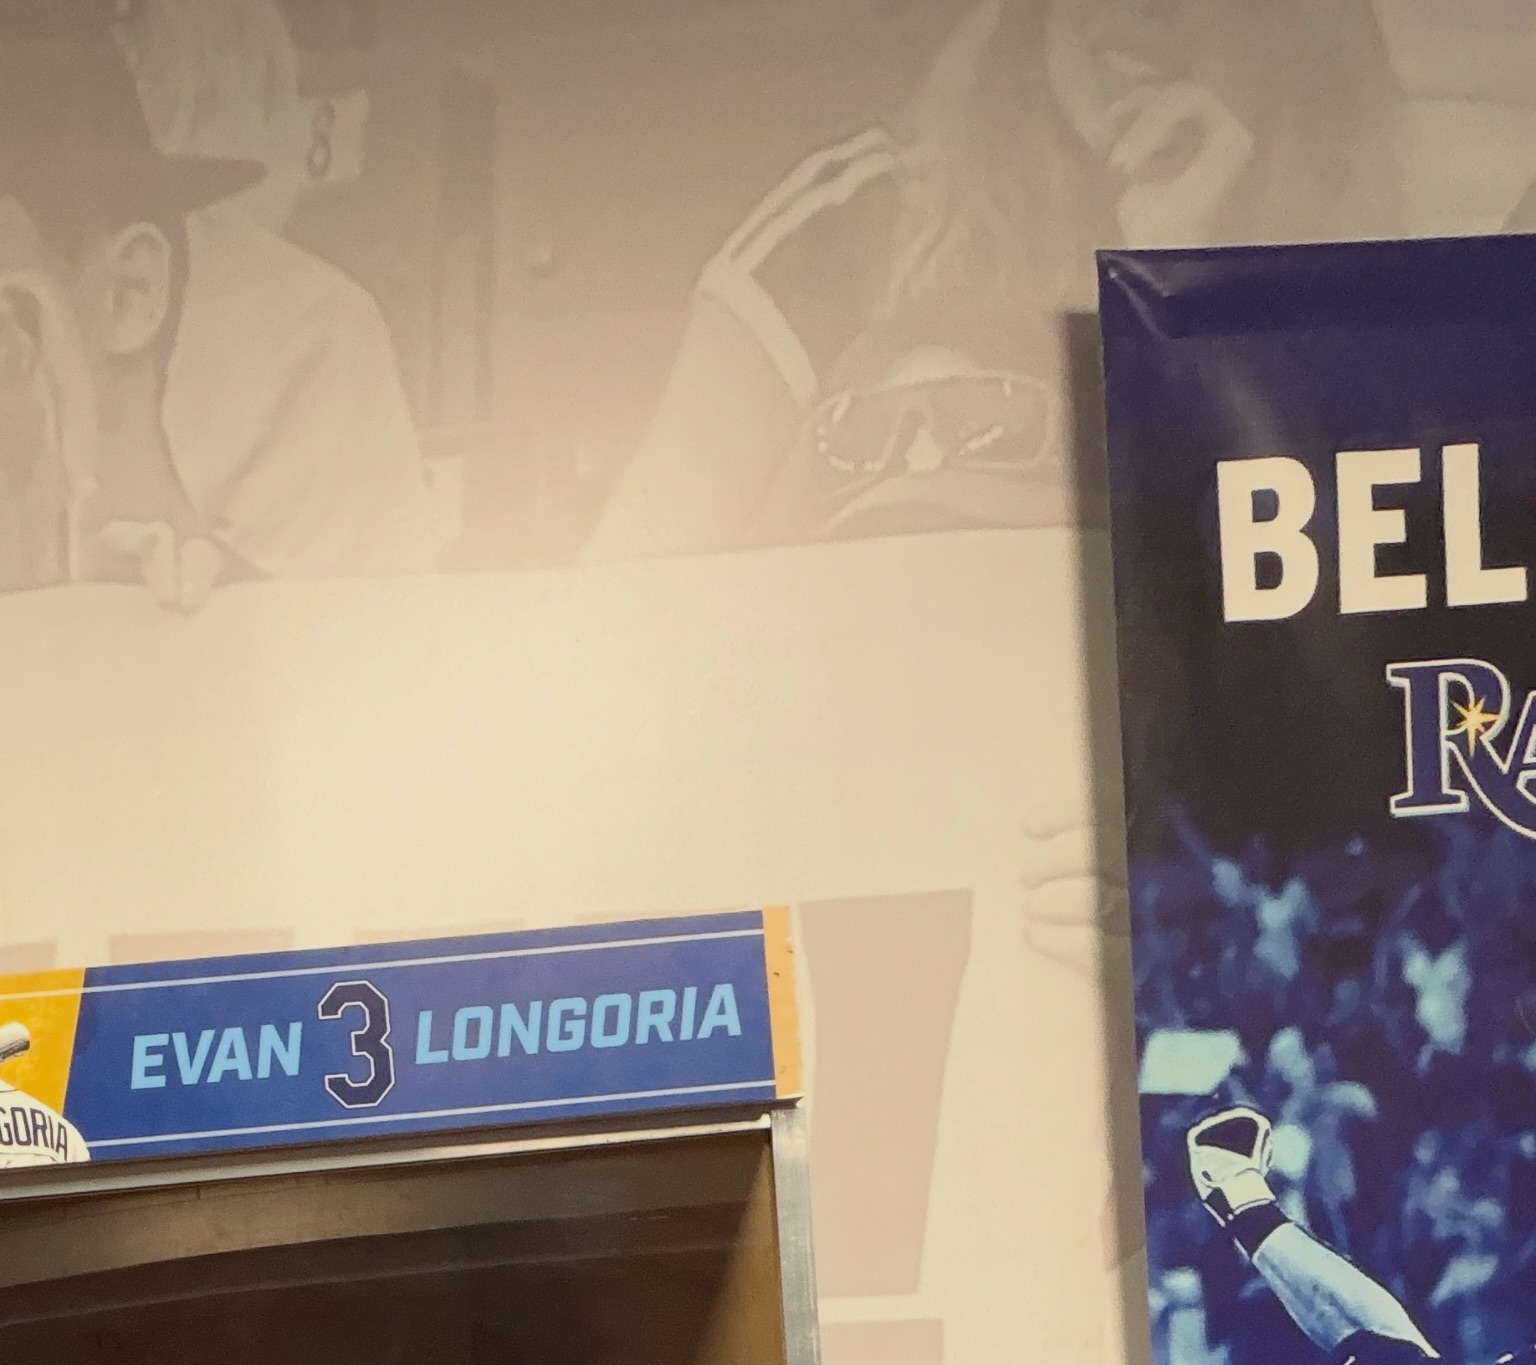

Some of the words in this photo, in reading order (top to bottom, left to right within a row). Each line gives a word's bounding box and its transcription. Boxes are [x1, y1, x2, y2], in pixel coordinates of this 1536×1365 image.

[1217, 442, 1528, 622] BEL
[130, 1021, 302, 1089] EVAN
[318, 980, 396, 1109] 3
[415, 983, 742, 1065] LONGORIA
